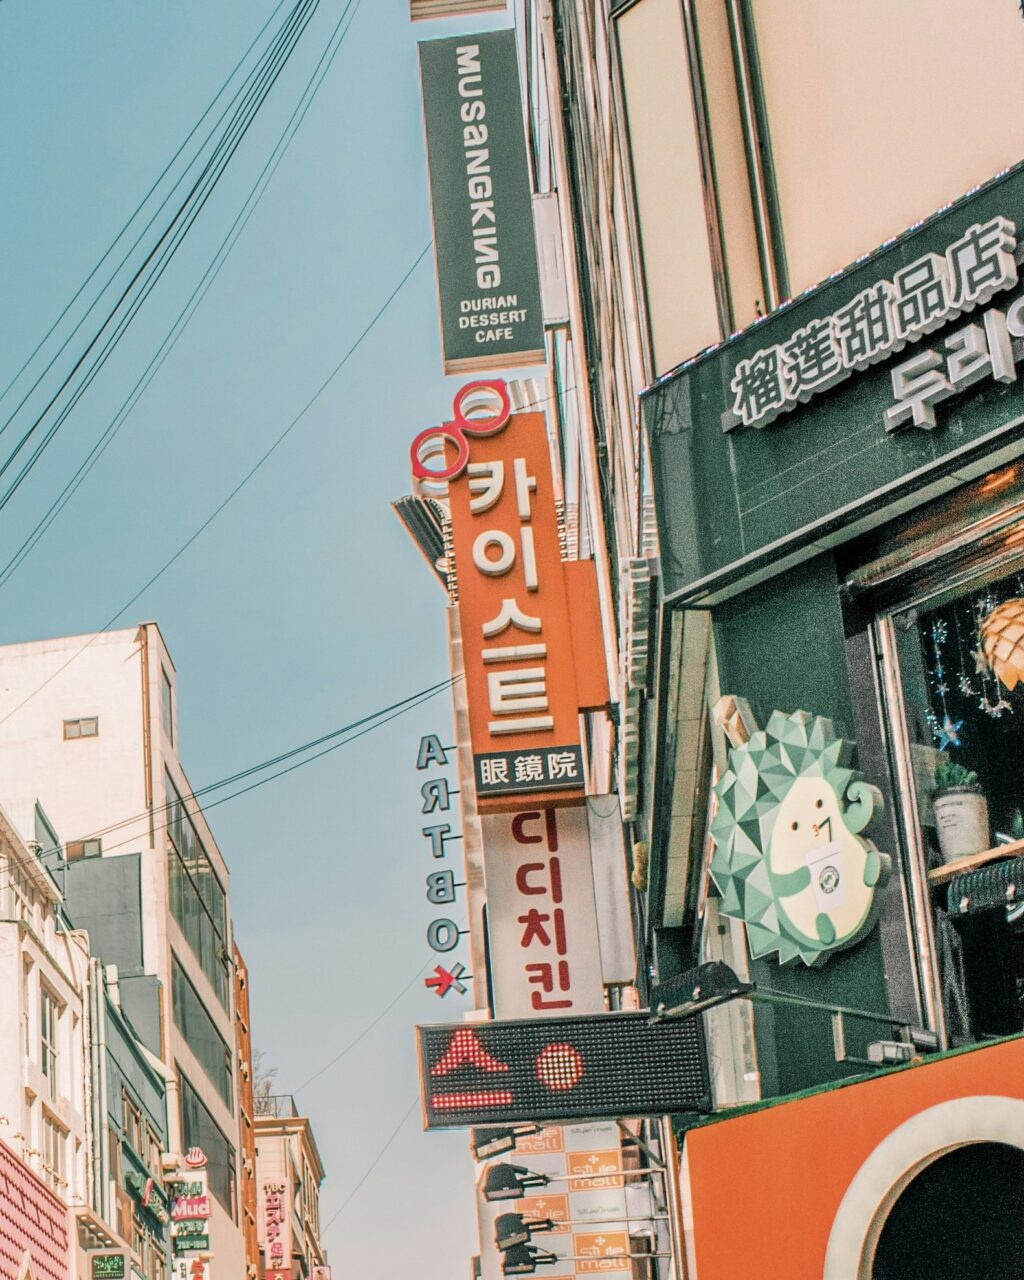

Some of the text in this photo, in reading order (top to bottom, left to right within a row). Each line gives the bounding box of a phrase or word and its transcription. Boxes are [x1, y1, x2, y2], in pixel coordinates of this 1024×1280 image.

[461, 295, 517, 312] DURIAN
[459, 309, 527, 329] DESSERT
[475, 327, 513, 343] CAFE
[466, 457, 555, 736] 카이스트
[480, 751, 577, 786] 眼鏡院
[512, 808, 573, 1010] 디디치킨
[172, 1201, 209, 1217] Mud
